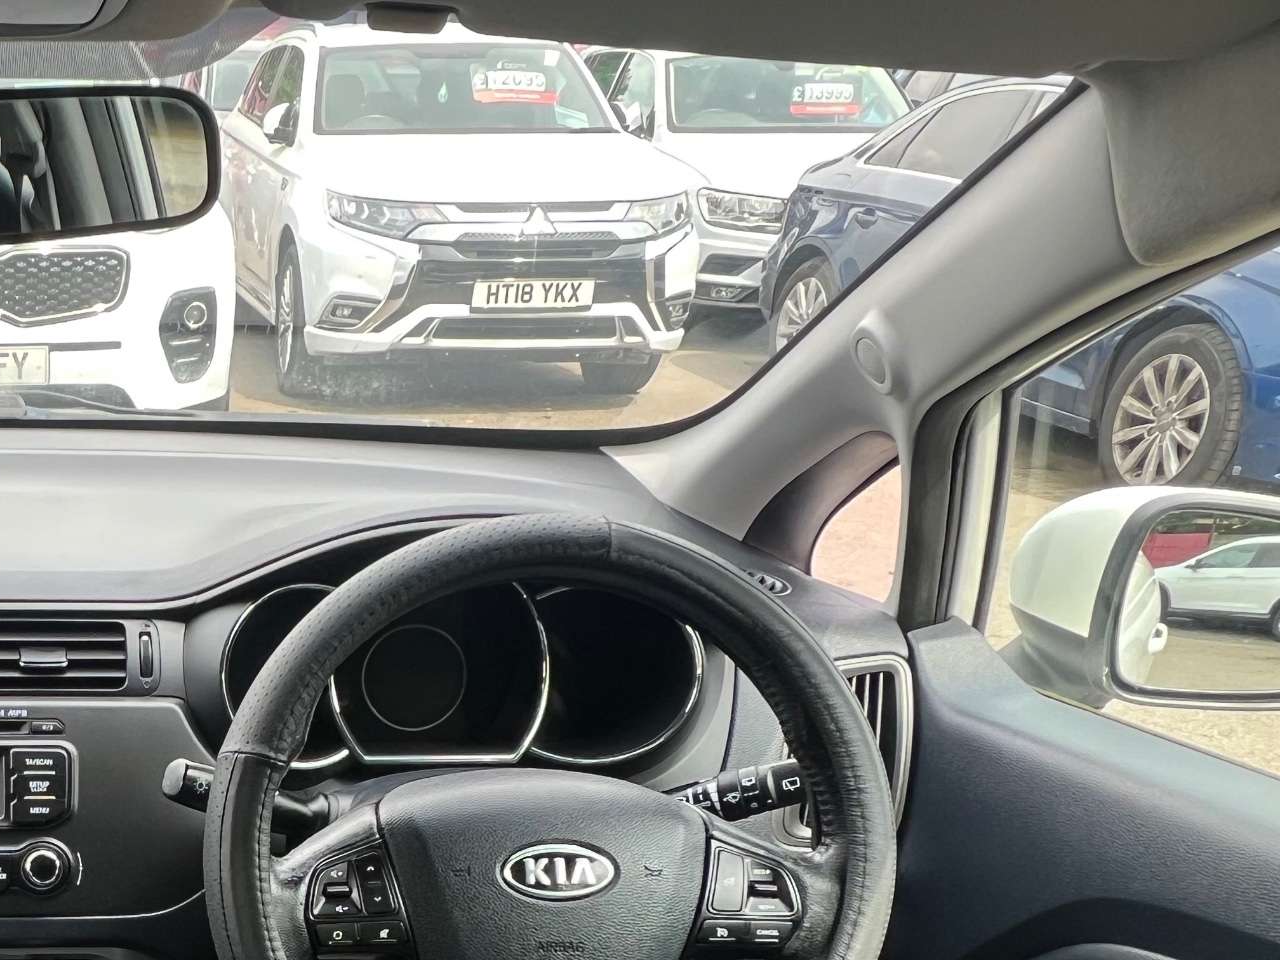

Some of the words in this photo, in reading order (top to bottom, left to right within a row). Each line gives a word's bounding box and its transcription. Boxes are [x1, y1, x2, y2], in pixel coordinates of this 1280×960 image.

[486, 283, 534, 304] HT18
[542, 282, 583, 303] YKX
[522, 857, 597, 886] KIA
